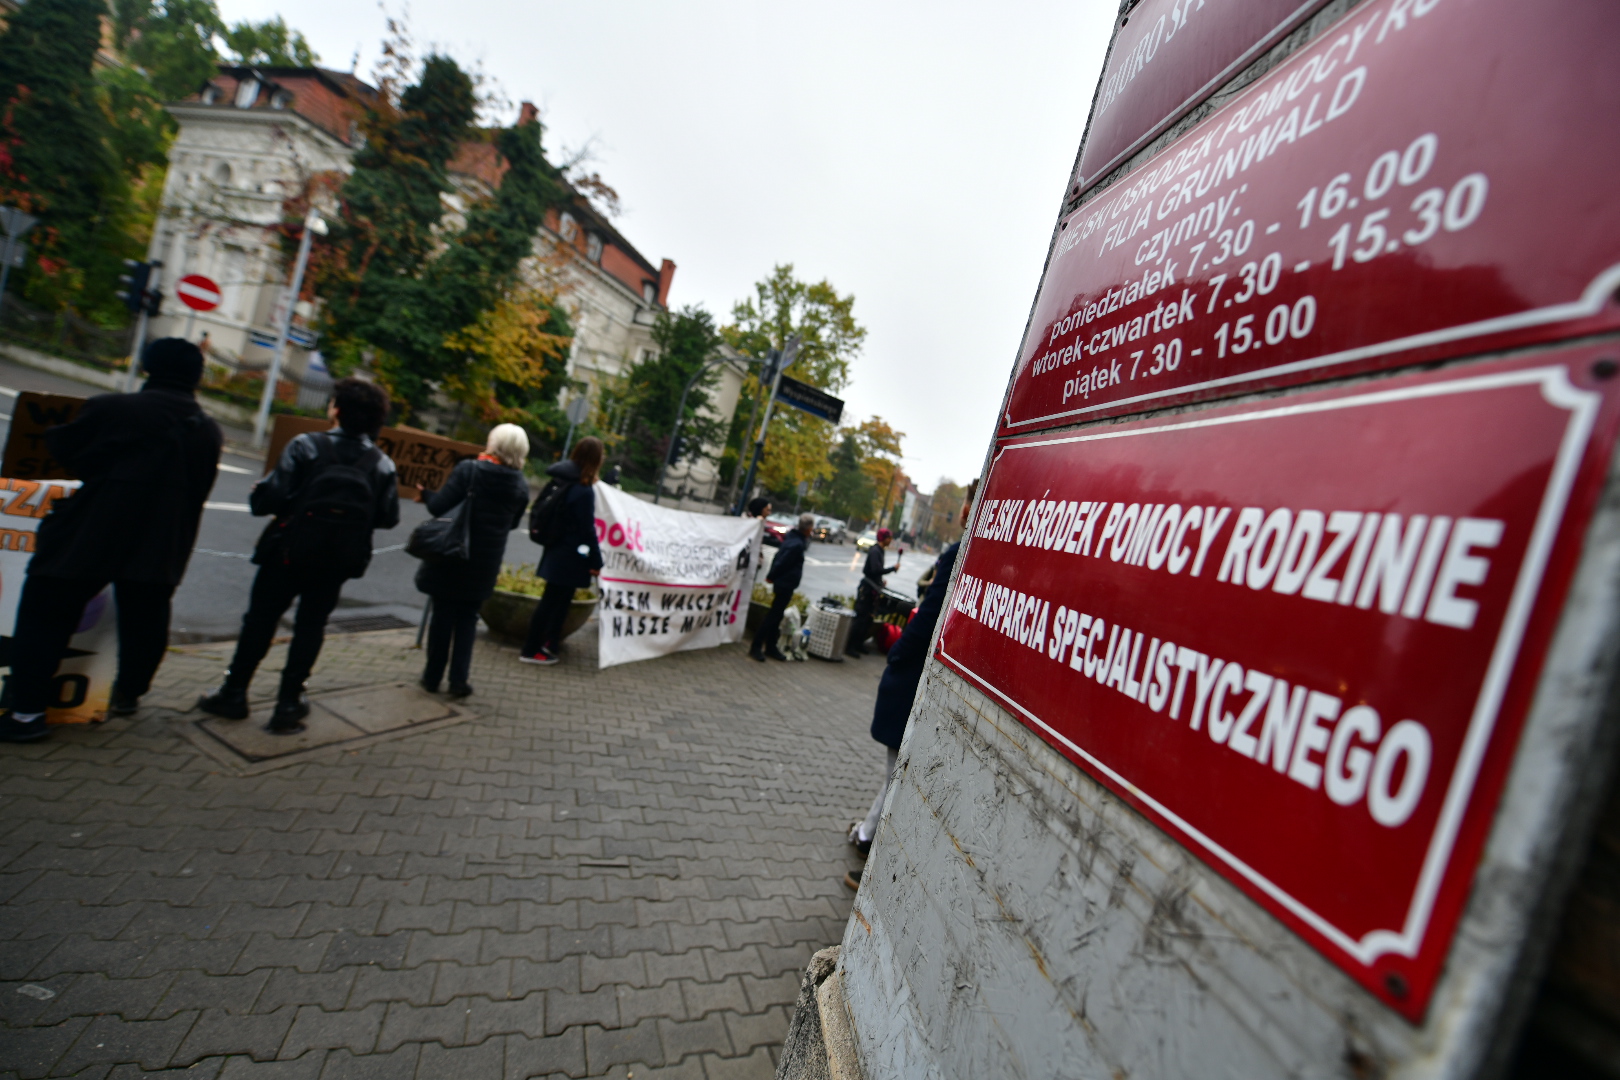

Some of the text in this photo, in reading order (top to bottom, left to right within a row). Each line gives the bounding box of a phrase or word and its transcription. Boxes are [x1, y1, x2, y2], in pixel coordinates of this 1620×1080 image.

[1054, 197, 1116, 263] MIEJSKI
[1111, 122, 1222, 220] OŚRODEK
[1217, 10, 1382, 148] POMOCY
[1098, 14, 1166, 118] BIURO
[1098, 66, 1367, 258] FILIA GRUNWALD
[1031, 288, 1197, 378] wtorek-czwartek
[1206, 251, 1282, 314] 7.30
[1328, 172, 1489, 271] 15.30
[1049, 257, 1179, 341] poniedziałek
[1186, 219, 1255, 278] 7.30
[1296, 133, 1438, 229] 16.00
[1134, 183, 1248, 266] czynny:
[1062, 364, 1122, 404] piątek
[1128, 336, 1183, 382] 7.30
[1213, 295, 1317, 359] 15.00
[973, 489, 1506, 629] MIEJSKI OŚRODEK POMOCY RODZINIE
[953, 572, 1433, 828] DZIAŁ WSPARCIA SPECJALISTYCZNEGO
